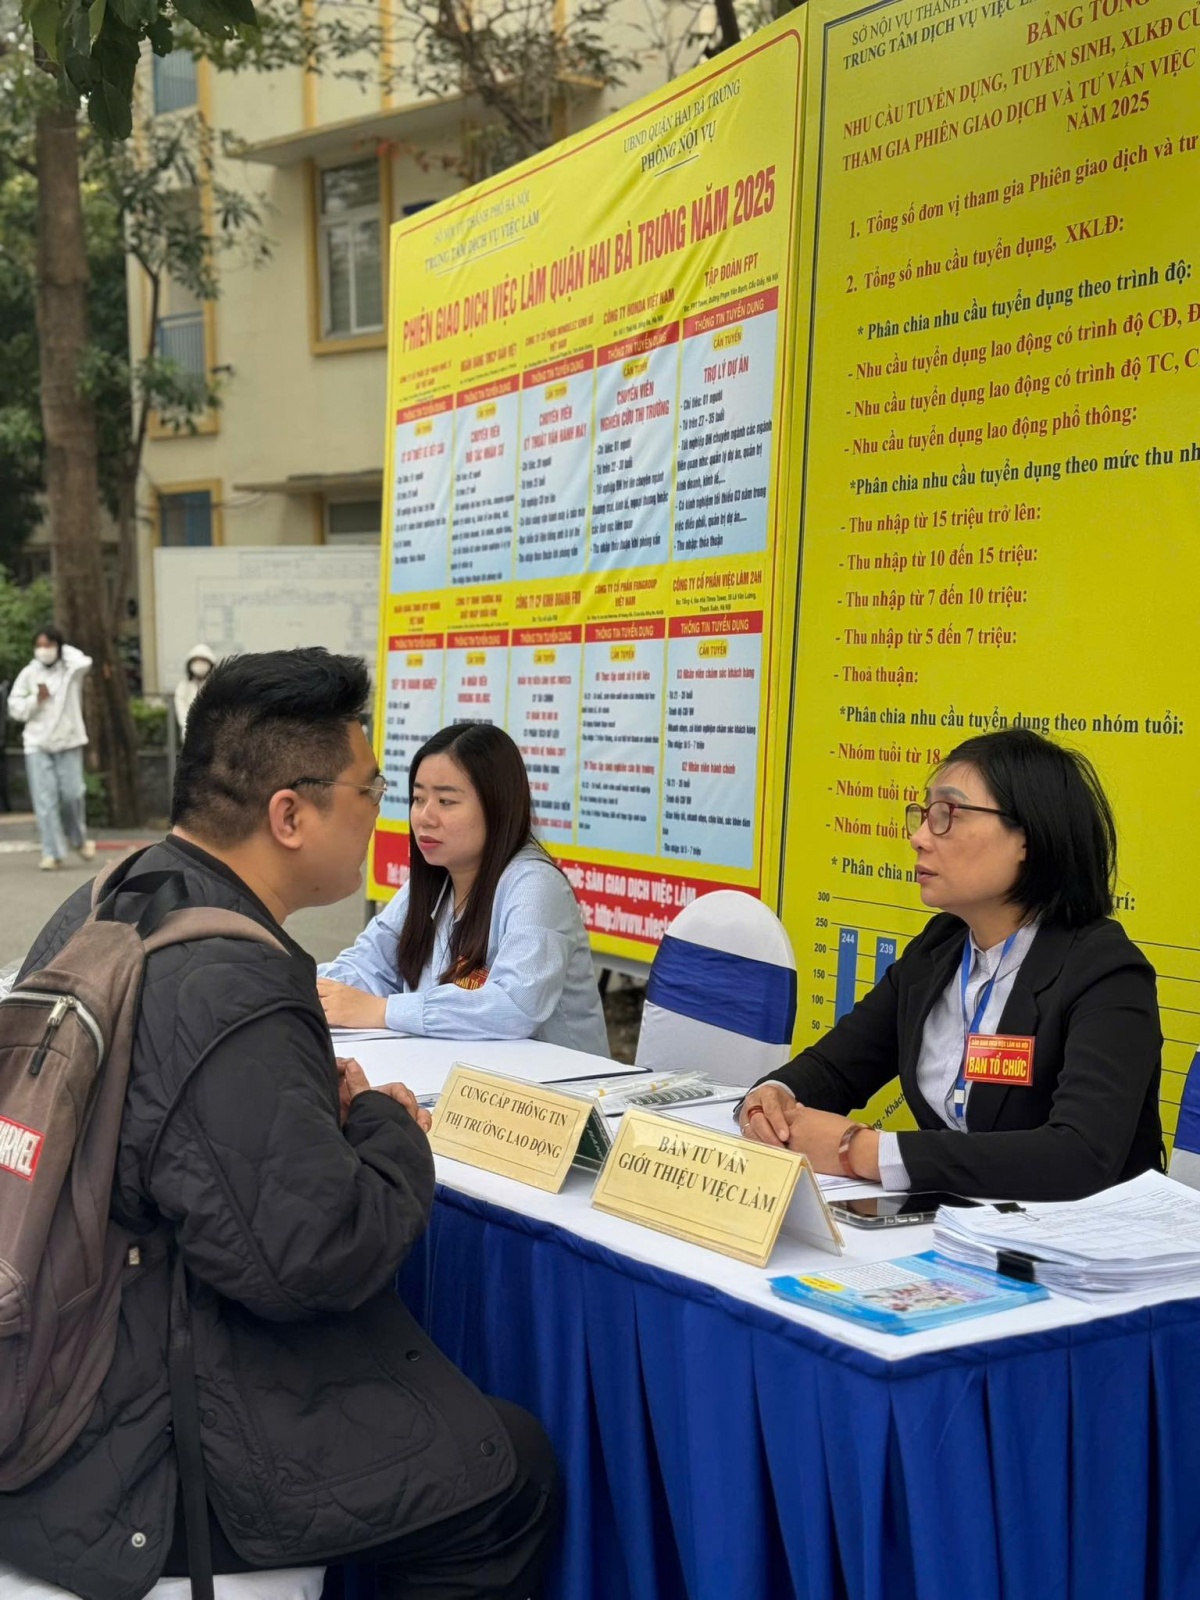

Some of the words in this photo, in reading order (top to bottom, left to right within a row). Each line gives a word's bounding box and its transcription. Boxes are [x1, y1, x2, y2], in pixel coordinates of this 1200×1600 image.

[843, 43, 886, 70] TRUNG
[889, 31, 918, 53] TÂM
[921, 21, 955, 42] DỊCH
[959, 8, 977, 28] VỤ
[853, 25, 867, 45] SỞ
[871, 16, 892, 38] NỘI
[896, 9, 913, 28] VỤ
[1026, 6, 1083, 45] BẢNG
[843, 115, 872, 140] NHU
[875, 103, 903, 130] CẦU
[907, 88, 955, 119] TUYỂN
[959, 72, 1008, 105] DỤNG,
[1012, 50, 1066, 85] TUYỂN
[1071, 35, 1115, 66] SINH,
[1121, 17, 1173, 49] XLKĐ
[842, 145, 882, 171] THAM
[885, 138, 911, 159] GIA
[914, 120, 959, 150] PHIÊN
[963, 108, 1002, 136] GIAO
[1006, 94, 1047, 125] DỊCH
[1052, 81, 1073, 107] VÀ
[1079, 72, 1105, 99] TƯ
[1107, 62, 1145, 90] VẤN
[1150, 47, 1196, 78] VIỆC
[1066, 105, 1106, 132] NĂM
[1111, 91, 1150, 119] 2025
[623, 130, 648, 154] UBND
[674, 105, 694, 128] HAI
[641, 144, 677, 173] PHÒNG
[678, 131, 699, 158] NỘI
[700, 121, 717, 145] VỤ
[867, 209, 898, 235] Tổng
[902, 202, 915, 224] số
[919, 202, 944, 221] đơn
[948, 194, 960, 217] vị
[964, 186, 999, 210] tham
[1003, 181, 1024, 204] gia
[1029, 169, 1071, 193] Phiên
[1075, 156, 1108, 184] giao
[1113, 145, 1148, 173] dịch
[1154, 139, 1173, 160] và
[1179, 132, 1199, 152] tư
[403, 307, 432, 352] PHIÊN
[436, 301, 461, 339] GIAO
[463, 291, 489, 338] DỊCH
[492, 273, 518, 326] VIỆC
[521, 271, 546, 310] LÀM
[550, 246, 585, 302] QUẬN
[589, 239, 612, 284] HAI
[614, 220, 632, 275] BÀ
[638, 204, 686, 265] TRƯNG
[691, 181, 729, 243] NĂM
[733, 165, 776, 227] 2025
[705, 271, 718, 288] TẬP
[721, 260, 742, 280] ĐOÀN
[744, 253, 758, 270] FPT
[846, 275, 857, 293] 2.
[864, 266, 895, 290] Tổng
[899, 262, 912, 283] số
[916, 259, 941, 278] nhu
[945, 248, 968, 271] cầu
[973, 238, 1011, 266] tuyển
[1016, 232, 1057, 257] dụng,
[1065, 214, 1125, 244] XKLĐ:
[695, 314, 714, 332] THÔNG
[716, 312, 725, 324] TIN
[726, 304, 745, 322] TUYỂN
[747, 299, 764, 316] DỤNG
[868, 321, 899, 340] Phân
[903, 315, 930, 332] chia
[934, 310, 959, 327] nhu
[964, 299, 987, 322] cầu
[992, 289, 1031, 317] tuyển
[1036, 286, 1073, 310] dụng
[1078, 272, 1112, 297] theo
[1116, 262, 1159, 290] trình
[1165, 259, 1192, 285] độ:
[704, 366, 717, 383] TRỢ
[718, 361, 727, 379] LÝ
[727, 360, 738, 379] DỰ
[739, 355, 749, 374] ÁN
[852, 438, 878, 455] Nhu
[882, 429, 904, 451] cầu
[908, 425, 944, 451] tuyển
[949, 425, 983, 447] dụng
[987, 421, 1008, 438] lao
[1012, 415, 1048, 439] động
[1052, 403, 1080, 435] phổ
[1085, 404, 1138, 428] thông:
[849, 517, 872, 534] Thu
[877, 512, 909, 534] nhập
[913, 508, 929, 528] từ
[932, 510, 948, 528] 15
[951, 504, 984, 527] triệu
[988, 504, 1011, 523] trở
[1014, 502, 1041, 521] lên:
[750, 570, 761, 584] 24H
[842, 666, 872, 683] Thoả
[876, 667, 919, 687] thuận:
[880, 707, 906, 724] chia
[911, 709, 937, 726] nhu
[940, 704, 964, 727] cầu
[969, 706, 1008, 733] tuyển
[1054, 713, 1087, 731] theo
[1092, 714, 1139, 733] nhóm
[1145, 709, 1184, 735] tuổi:
[585, 867, 603, 892] SÀN
[605, 873, 626, 896] GIAO
[627, 877, 649, 903] DỊCH
[652, 879, 672, 908] VIỆC
[842, 857, 874, 876] Phân
[878, 863, 902, 882] chia
[818, 892, 830, 902] 300
[816, 918, 828, 929] 250
[841, 933, 855, 944] 244
[814, 943, 827, 954] 200
[880, 943, 894, 954] 239
[813, 969, 825, 980] 150
[812, 995, 824, 1006] 100
[812, 1021, 820, 1031] 50
[968, 1057, 987, 1074] BAN
[990, 1052, 1001, 1075] TỔ
[1002, 1056, 1026, 1077] CHỨC
[460, 1084, 488, 1107] CUNG
[489, 1090, 511, 1110] CẤP
[510, 1098, 547, 1123] THÔNG
[548, 1108, 569, 1127] TIN
[446, 1111, 464, 1133] THỊ
[464, 1115, 506, 1142] TRƯỜNG
[505, 1126, 529, 1148] LAO
[528, 1134, 562, 1159] ĐỘNG
[658, 1134, 688, 1156] BÀN
[688, 1141, 716, 1164] TƯ
[718, 1147, 749, 1175] VẤN
[618, 1150, 650, 1175] GIỚI
[652, 1159, 701, 1189] THIỆU
[701, 1172, 740, 1204] VIỆC
[740, 1179, 776, 1213] LÀM
